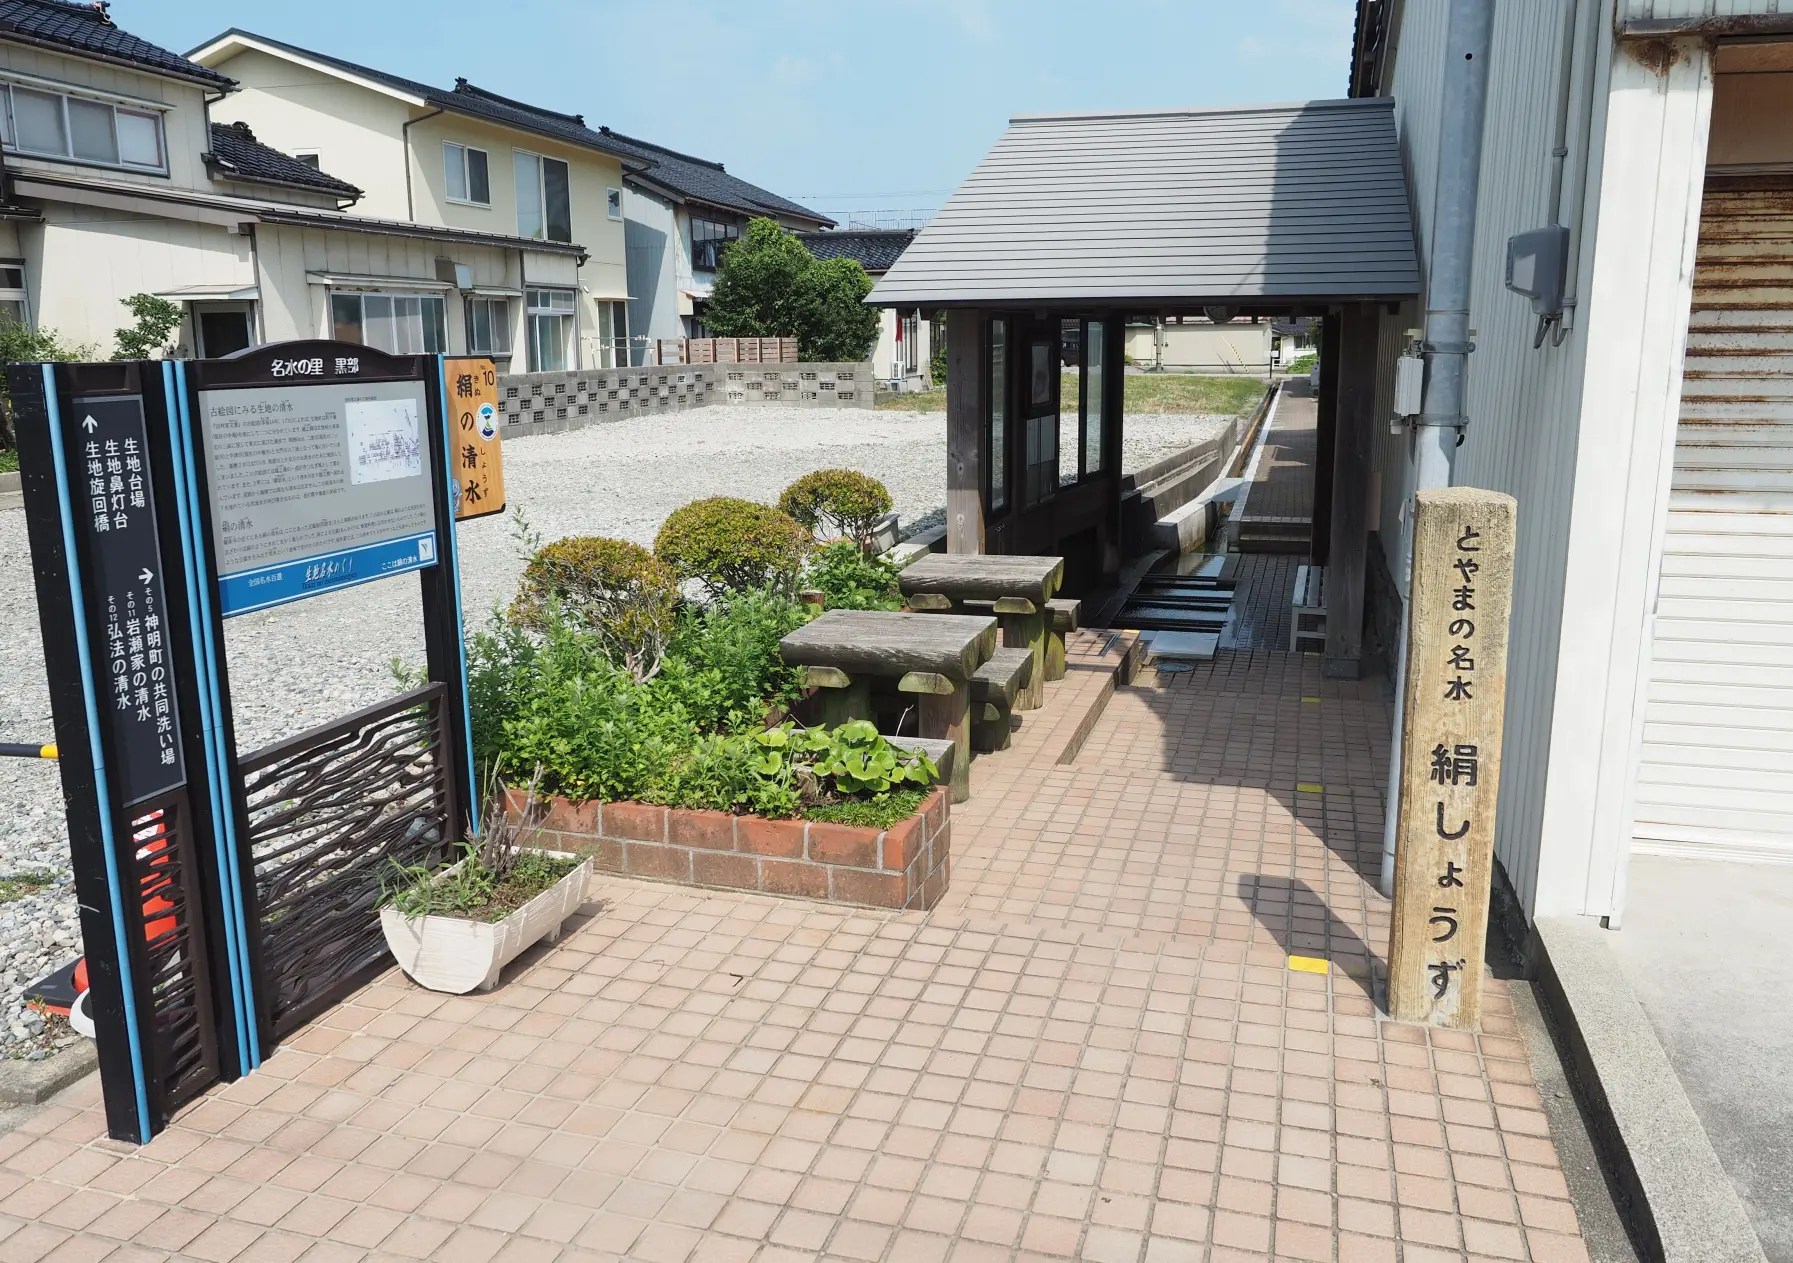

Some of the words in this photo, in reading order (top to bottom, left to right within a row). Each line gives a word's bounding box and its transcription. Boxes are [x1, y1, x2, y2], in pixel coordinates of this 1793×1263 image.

[271, 358, 324, 377] 名水の里
[334, 357, 360, 375] 黒部
[474, 375, 481, 396] きぬ
[483, 370, 495, 386] 10
[209, 401, 294, 418] 古絵図にみる生地の清水
[456, 373, 482, 505] 絹の清水
[85, 441, 110, 533] 生地旋回橋
[104, 439, 129, 530] 生地鼻灯台
[124, 437, 145, 508] 生地台場
[480, 446, 489, 498] しょうず
[1443, 525, 1480, 701] とやまの名水
[1426, 742, 1478, 1001] 絹しょうず
